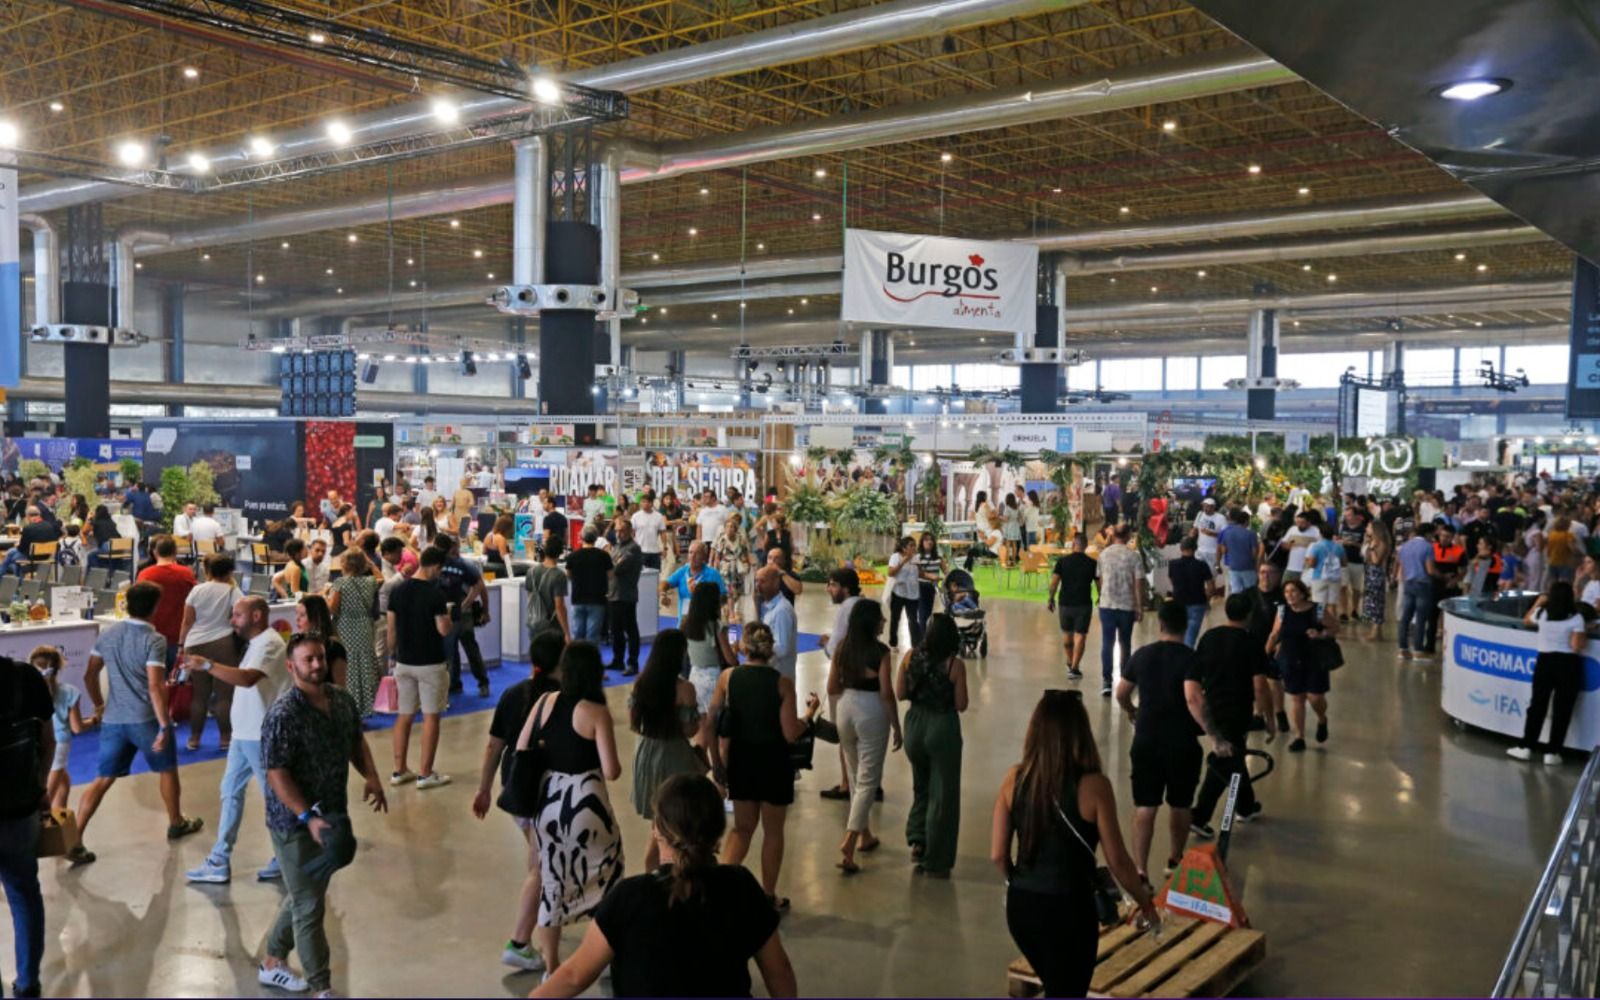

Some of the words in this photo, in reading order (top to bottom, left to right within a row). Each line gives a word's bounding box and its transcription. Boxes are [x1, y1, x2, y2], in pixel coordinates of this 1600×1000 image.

[886, 252, 998, 297] Burgos
[687, 466, 757, 506] SEGURA
[1460, 643, 1537, 676] INFORMAC
[1494, 692, 1522, 717] IFA
